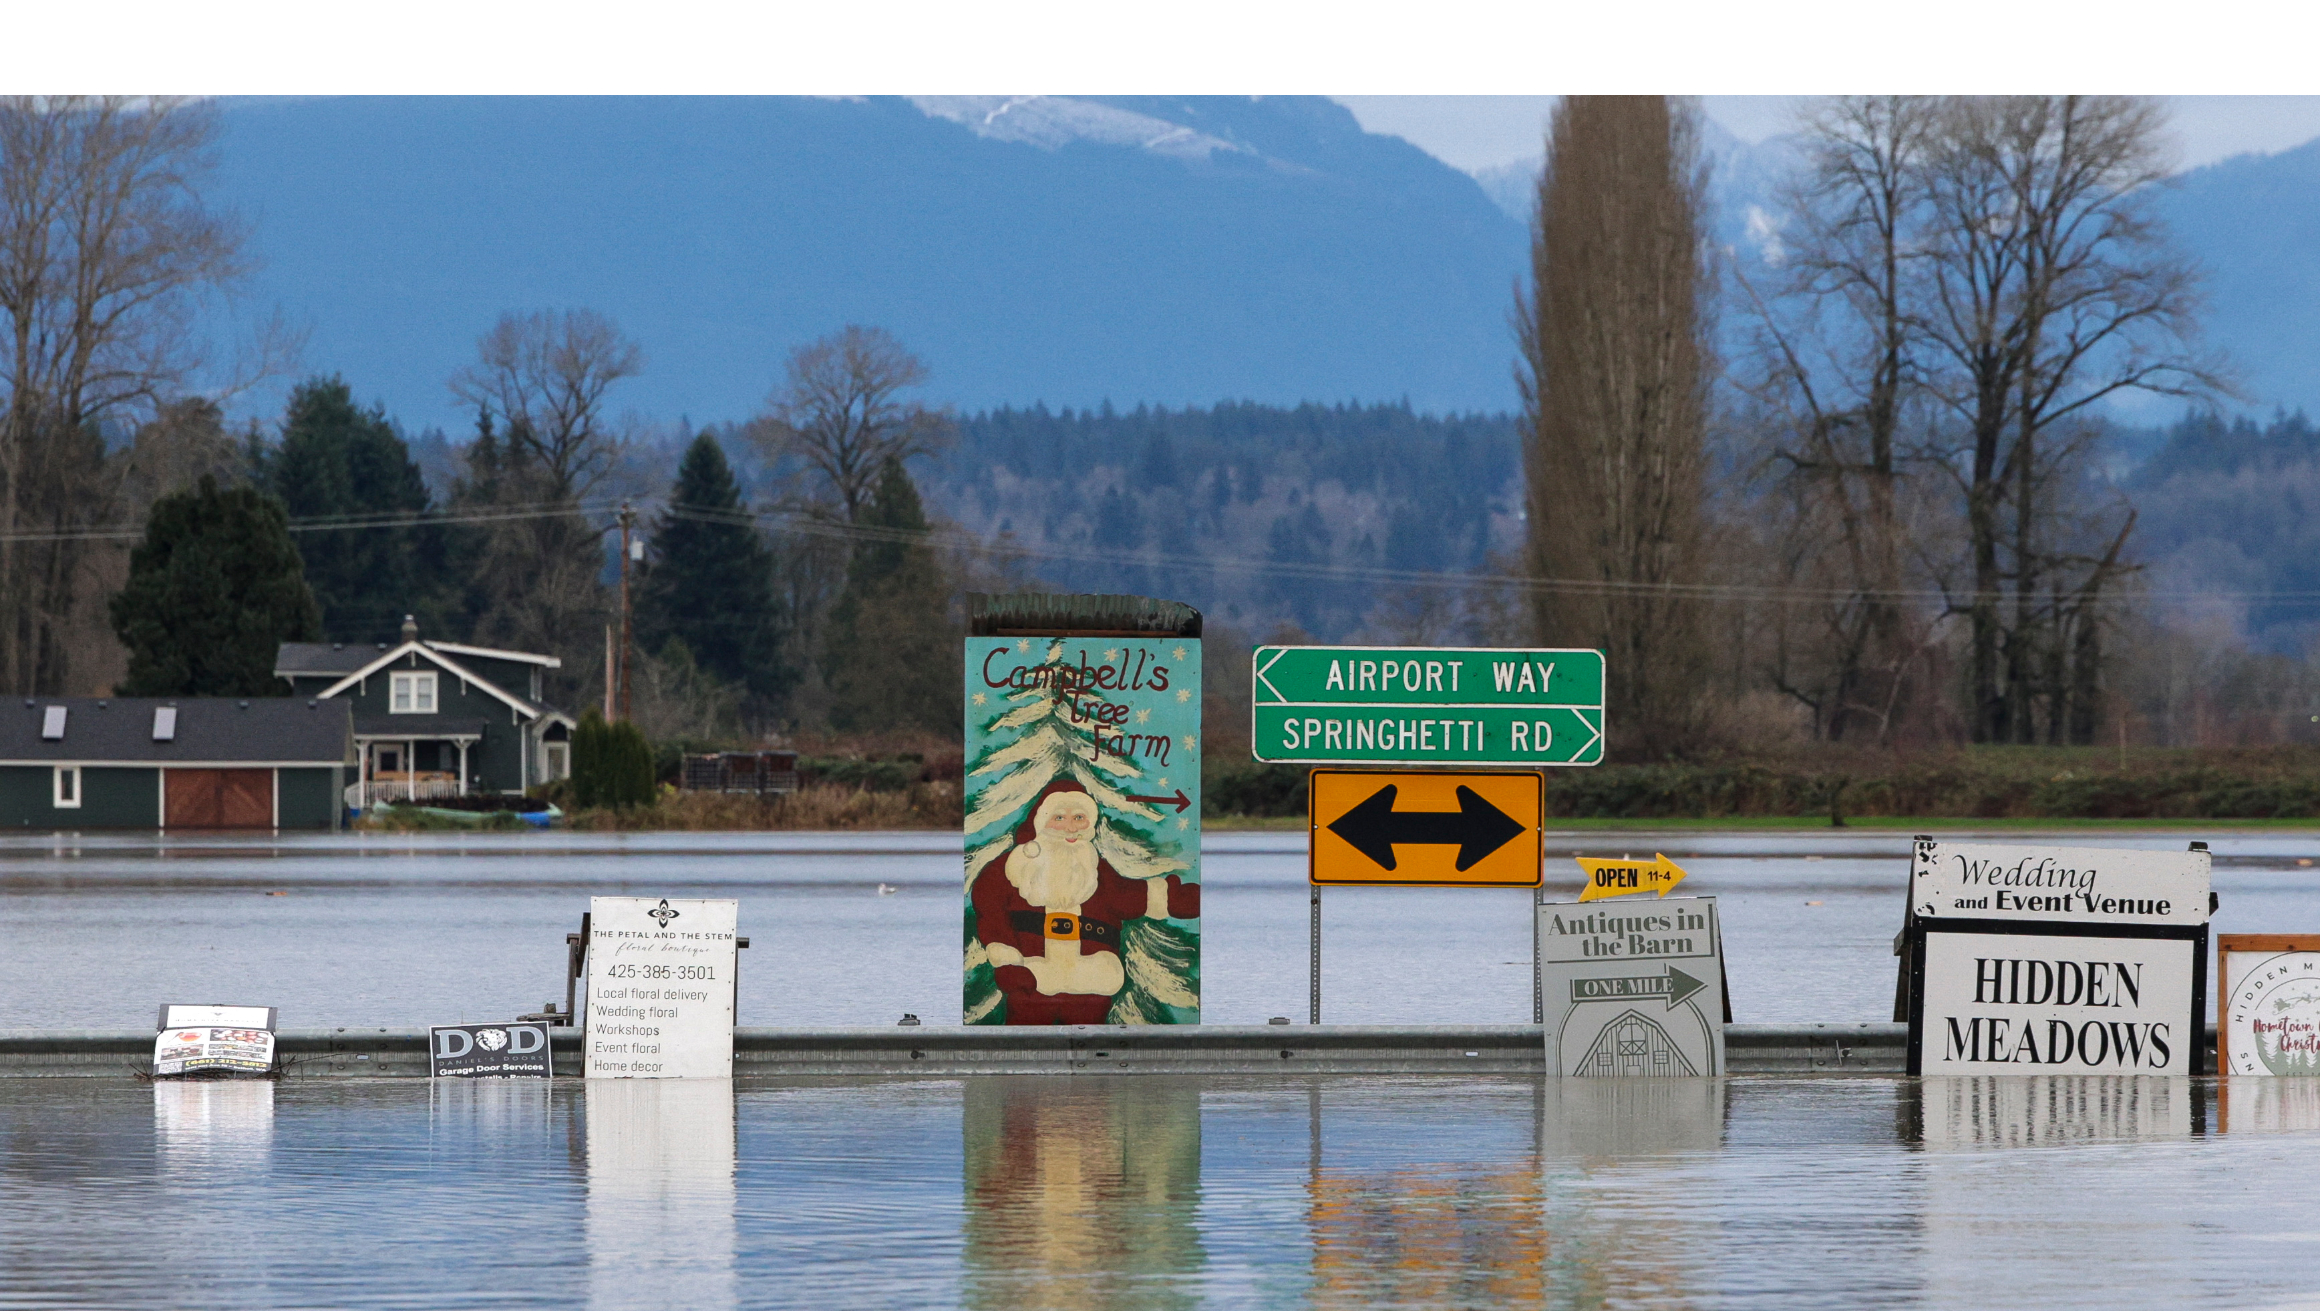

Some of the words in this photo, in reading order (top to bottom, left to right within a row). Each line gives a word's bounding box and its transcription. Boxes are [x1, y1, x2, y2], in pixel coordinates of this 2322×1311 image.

[983, 647, 1169, 705] Campbell's
[1325, 659, 1464, 692] AIRPORT
[1492, 661, 1556, 693] WAY
[1066, 690, 1130, 724] Tree
[1090, 724, 1171, 767] Farm
[1282, 718, 1485, 751] SPRINGHETTI
[1511, 720, 1553, 752] RD
[1595, 867, 1639, 888] OPEN
[1647, 870, 1672, 882] 11-4
[1951, 854, 2097, 899] Wedding
[1954, 896, 1989, 910] and
[1996, 890, 2074, 913] Event
[2083, 892, 2172, 916] Venue
[1548, 911, 1671, 940] Antiques
[1677, 907, 1705, 931] in
[594, 930, 614, 938] THE
[618, 931, 650, 939] PETAL
[680, 932, 701, 940] THE
[705, 933, 733, 941] STEM
[1582, 935, 1622, 957] the
[1627, 934, 1694, 956] Barn
[615, 942, 654, 957] floral
[660, 942, 710, 957] boutique
[607, 964, 717, 981] 425-385-3501
[1971, 957, 2144, 1009] HIDDEN
[597, 987, 628, 999] Local
[631, 988, 660, 1000] floral
[663, 988, 709, 1002] delivery
[1583, 979, 1624, 996] ONE
[1627, 977, 1674, 995] MILE
[2235, 965, 2288, 1023] HIDDEN
[596, 1005, 646, 1020] Wedding
[649, 1006, 679, 1018] floral
[595, 1023, 661, 1038] Workshops
[2253, 1015, 2314, 1037] Hometown
[595, 1041, 628, 1054] Event
[632, 1042, 661, 1054] floral
[1942, 1016, 2172, 1069] MEADOWS
[438, 1056, 496, 1067] DANIEL'S
[439, 1066, 475, 1076] Garage
[476, 1064, 501, 1072] Door
[502, 1063, 545, 1071] Services
[594, 1059, 628, 1071] Home
[631, 1060, 664, 1072] decor
